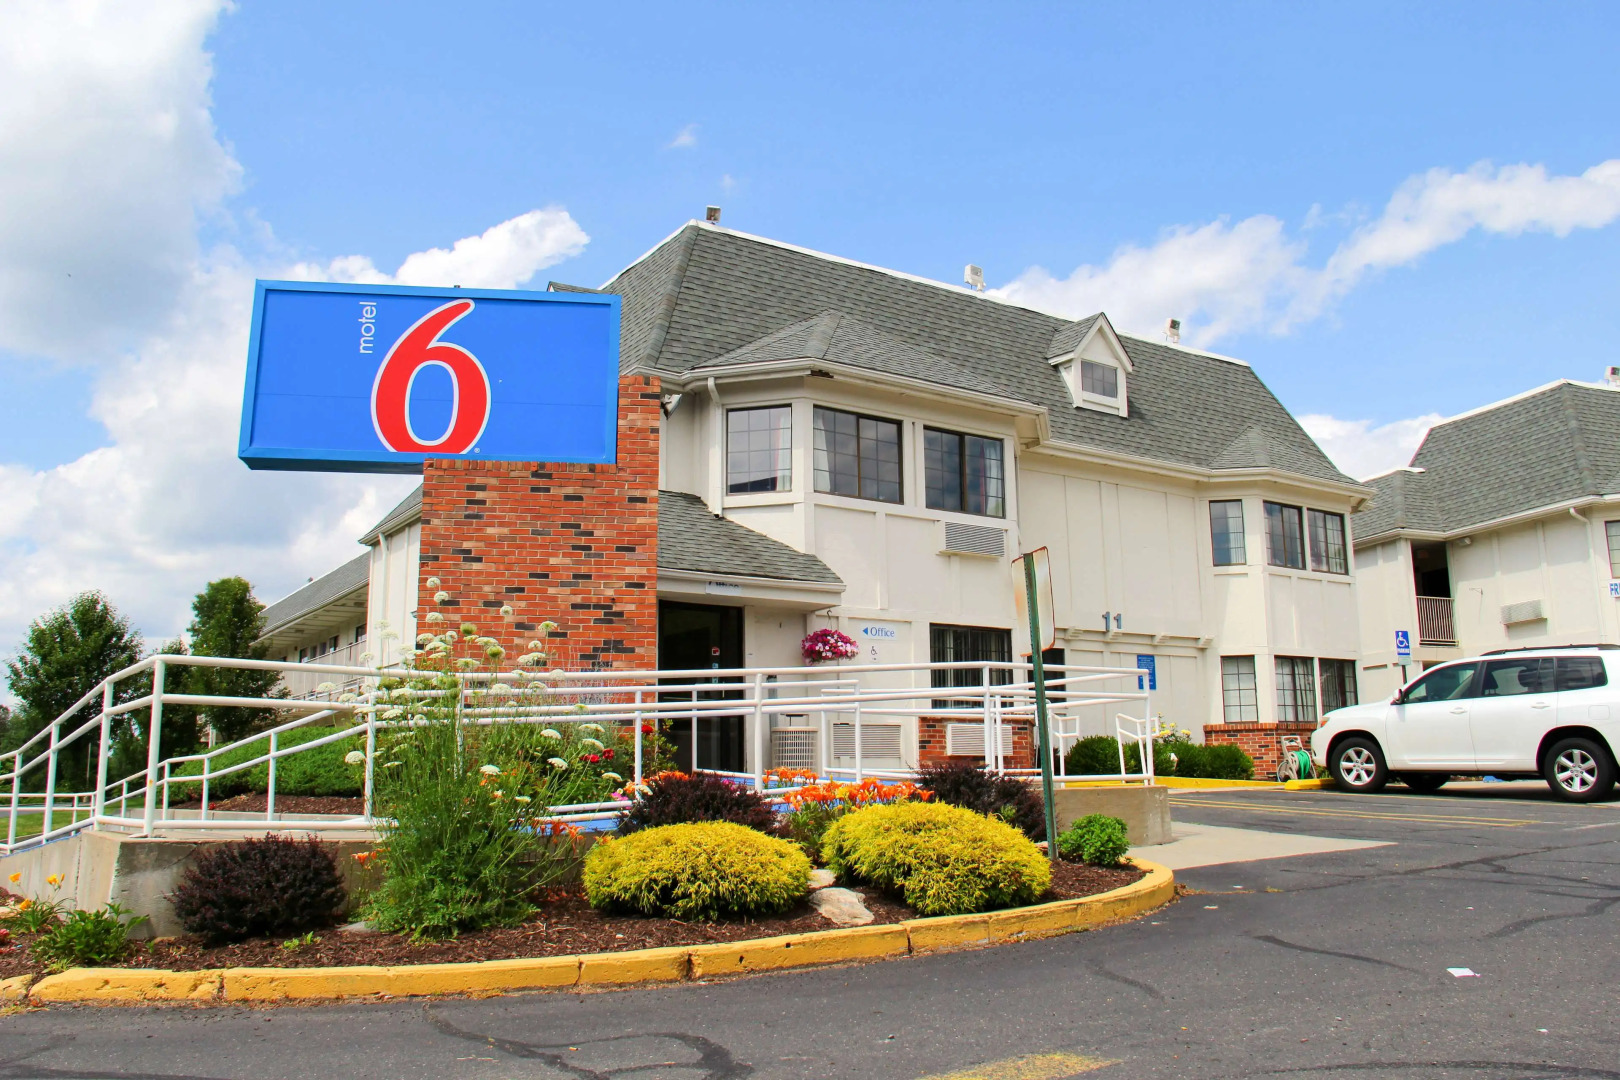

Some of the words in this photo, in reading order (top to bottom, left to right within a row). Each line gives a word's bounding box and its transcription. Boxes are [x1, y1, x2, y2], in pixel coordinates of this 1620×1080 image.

[358, 301, 377, 354] motel
[370, 298, 492, 454] 6
[1610, 582, 1620, 596] FR
[870, 626, 895, 638] Office
